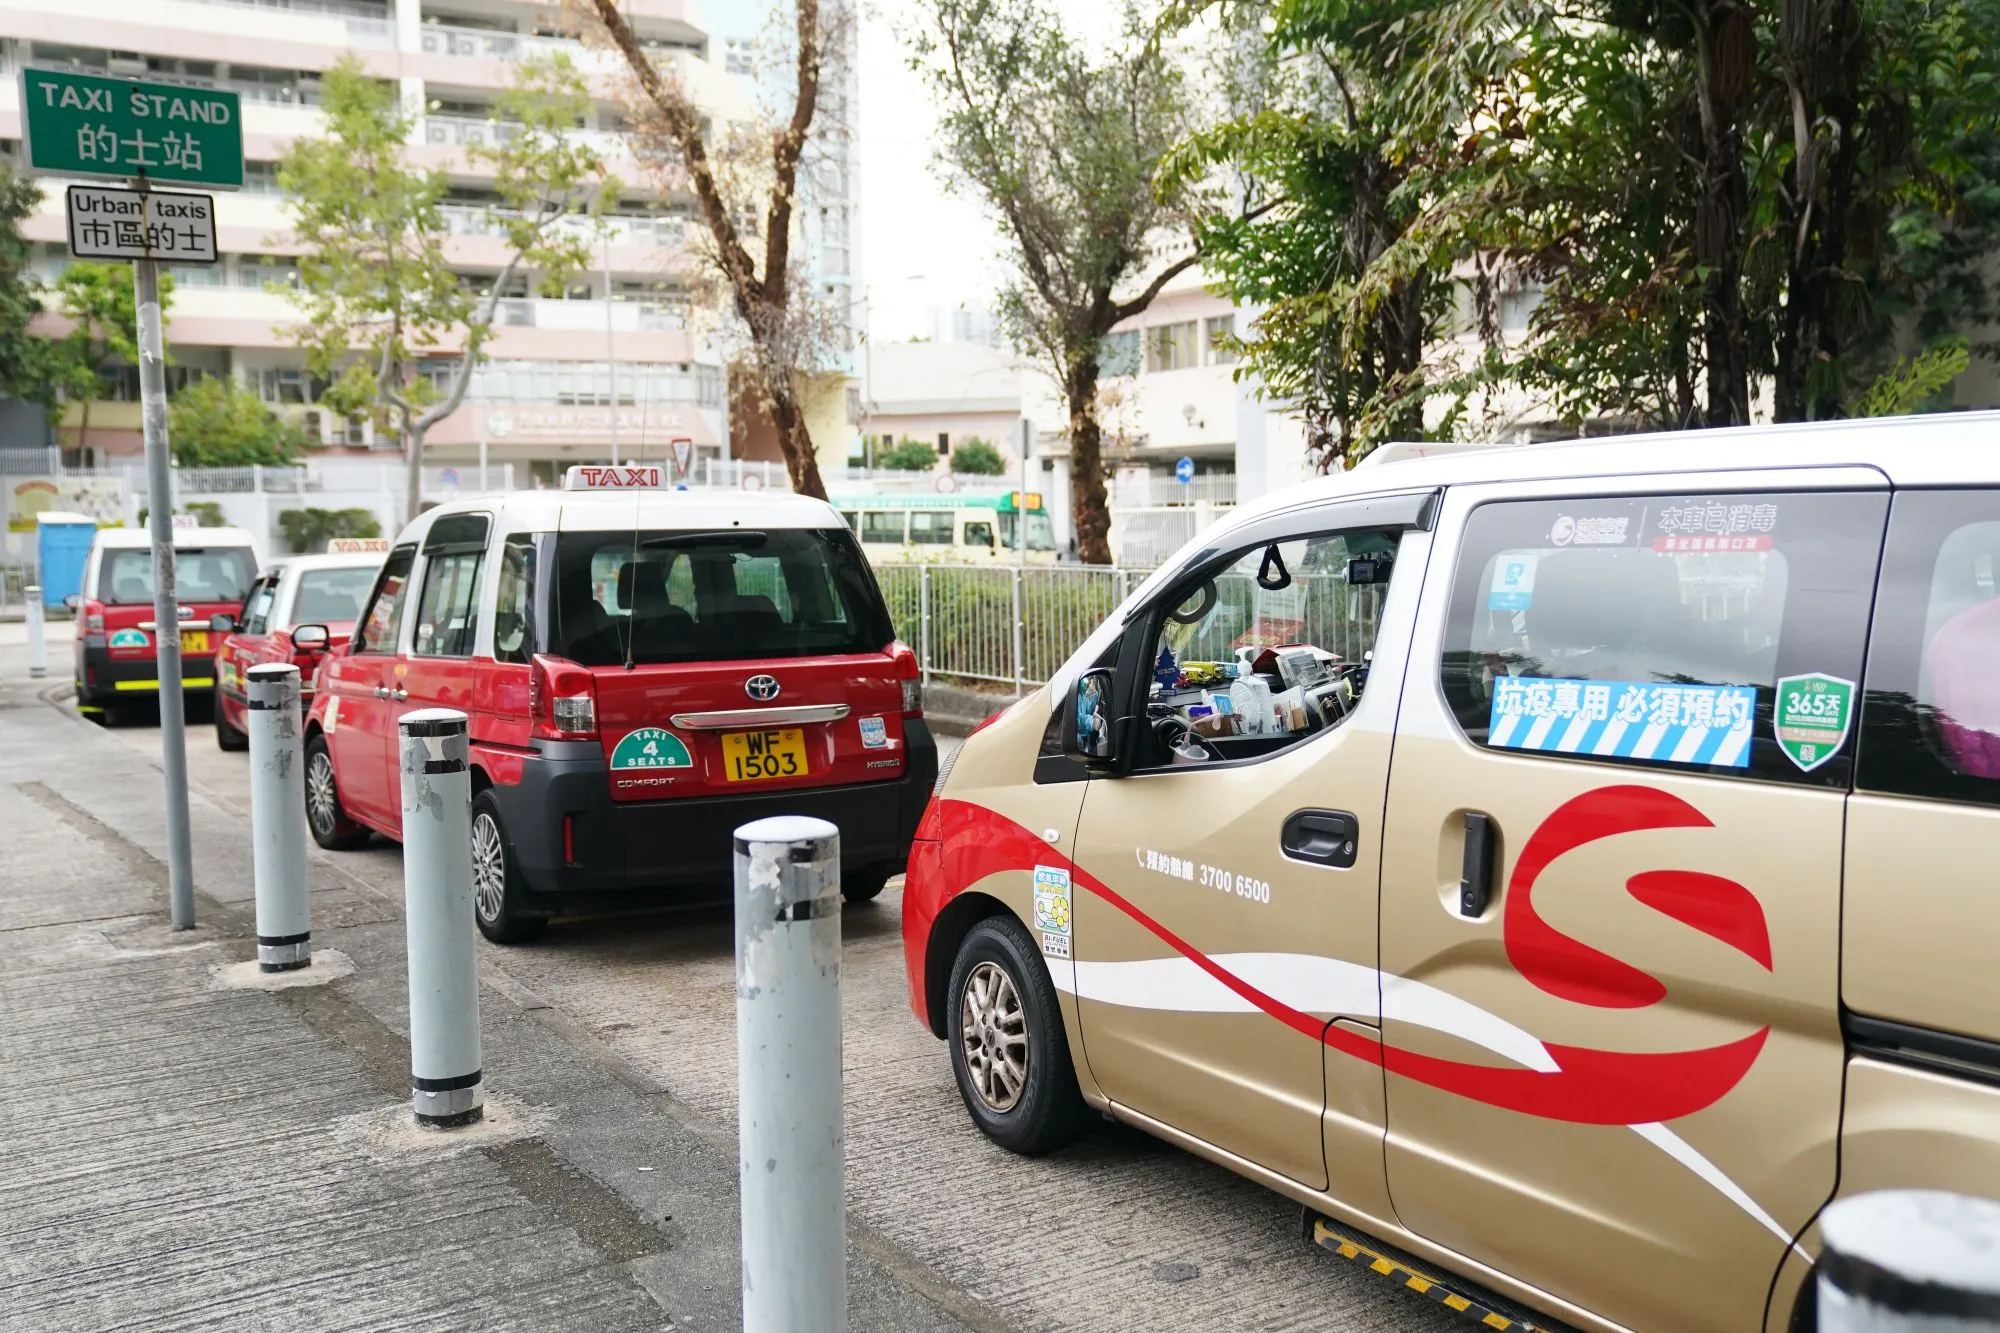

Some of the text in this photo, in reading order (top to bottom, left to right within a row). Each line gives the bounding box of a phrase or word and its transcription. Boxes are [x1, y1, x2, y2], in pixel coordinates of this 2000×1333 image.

[38, 82, 230, 125] TAXI STAND
[77, 122, 203, 171] 的士站
[75, 194, 206, 219] Urban taxis
[80, 218, 206, 252] 市區的士
[580, 468, 659, 487] TAXI
[1658, 503, 1777, 533] 本車已消毒
[334, 540, 389, 553] TAXI
[1496, 679, 1751, 731] 抗疫專用 必須預約
[633, 730, 667, 741] TAXI
[642, 740, 659, 756] 4
[745, 731, 780, 755] WF
[627, 756, 676, 766] SEATS
[735, 752, 798, 780] 1503
[617, 777, 675, 788] COMFORT
[1199, 864, 1232, 893] 3700
[1236, 874, 1270, 904] 6500
